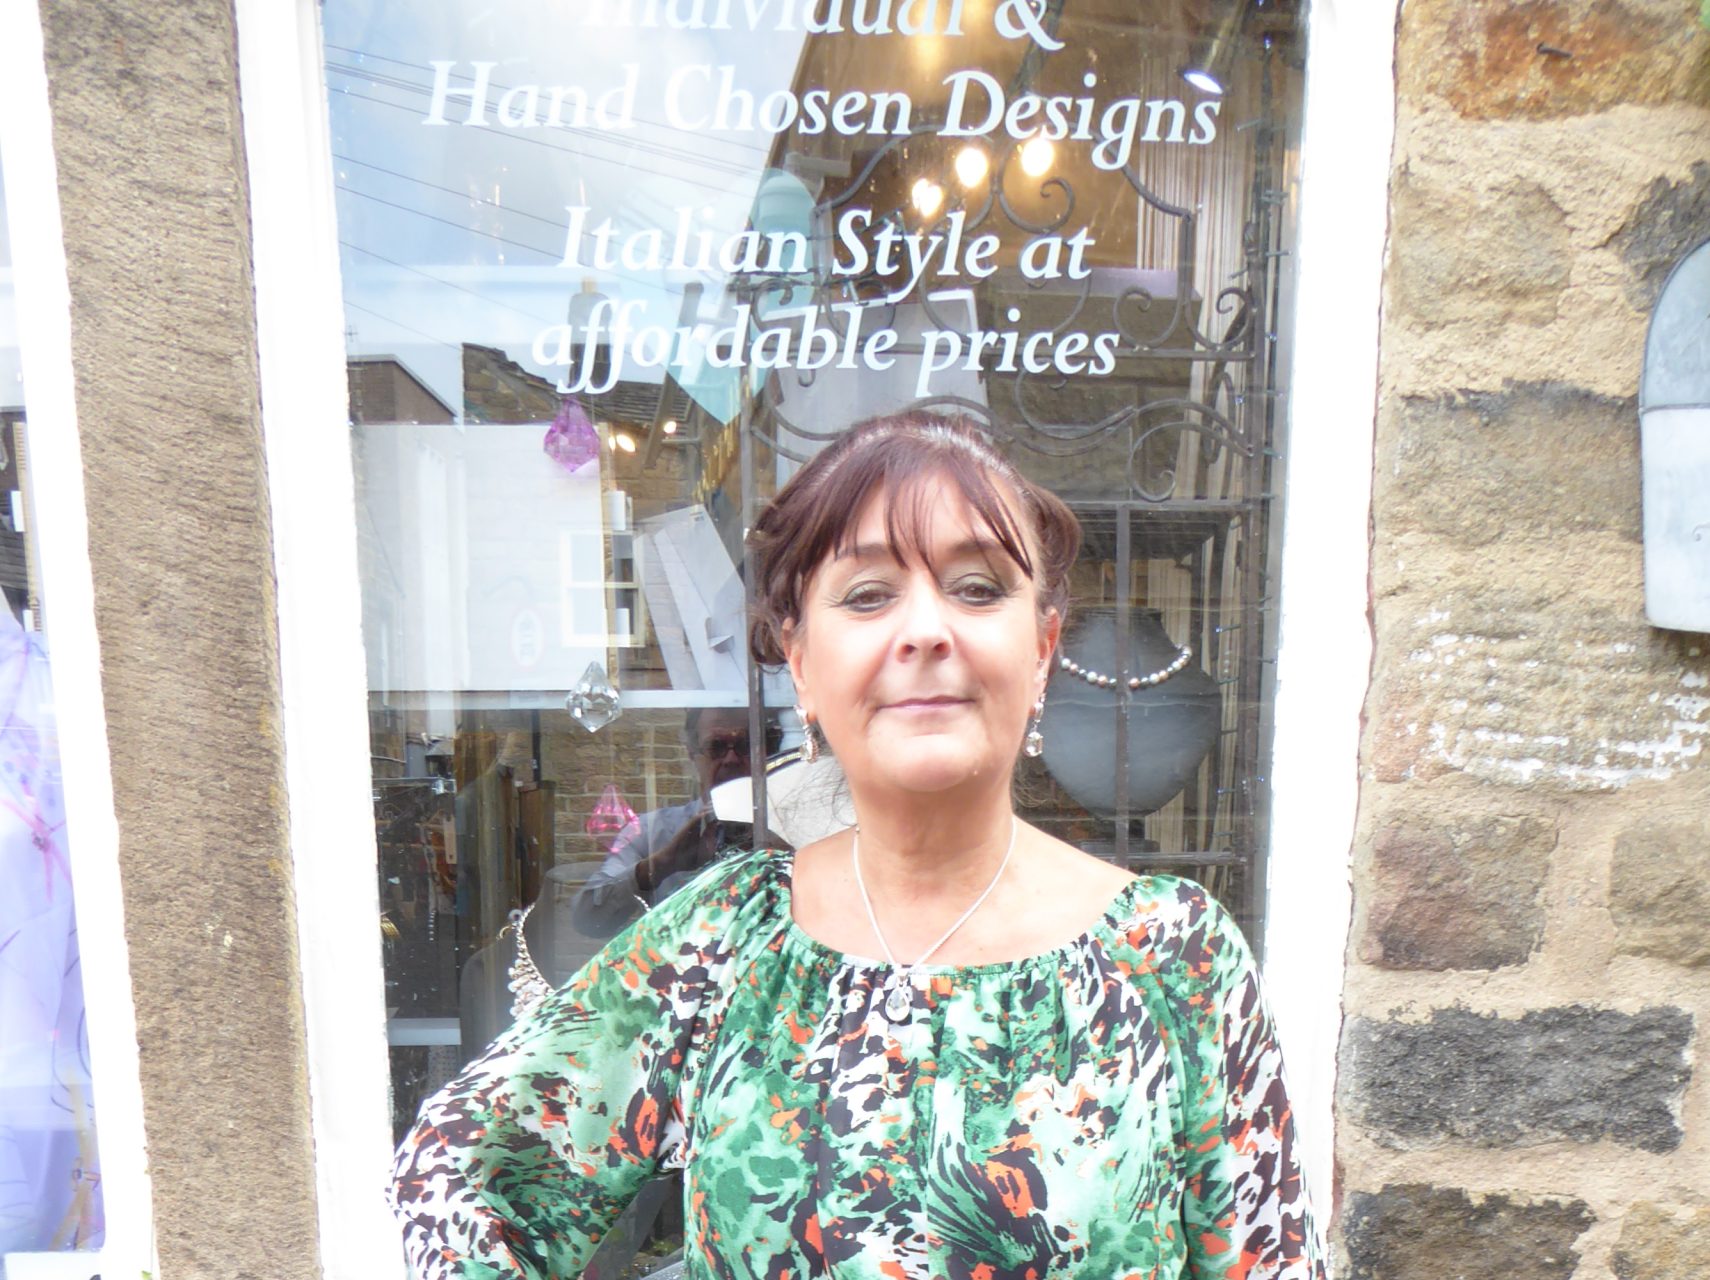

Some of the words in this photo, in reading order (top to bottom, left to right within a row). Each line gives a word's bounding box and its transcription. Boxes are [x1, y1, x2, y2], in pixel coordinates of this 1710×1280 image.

[993, 0, 1066, 51] &
[421, 60, 641, 130] Hand
[664, 64, 911, 135] Chosen
[937, 70, 1221, 170] Designs
[556, 206, 808, 273] Italian
[832, 209, 1000, 302] Style
[1020, 227, 1096, 280] at
[531, 299, 898, 395] affordable
[915, 307, 1120, 398] prices
